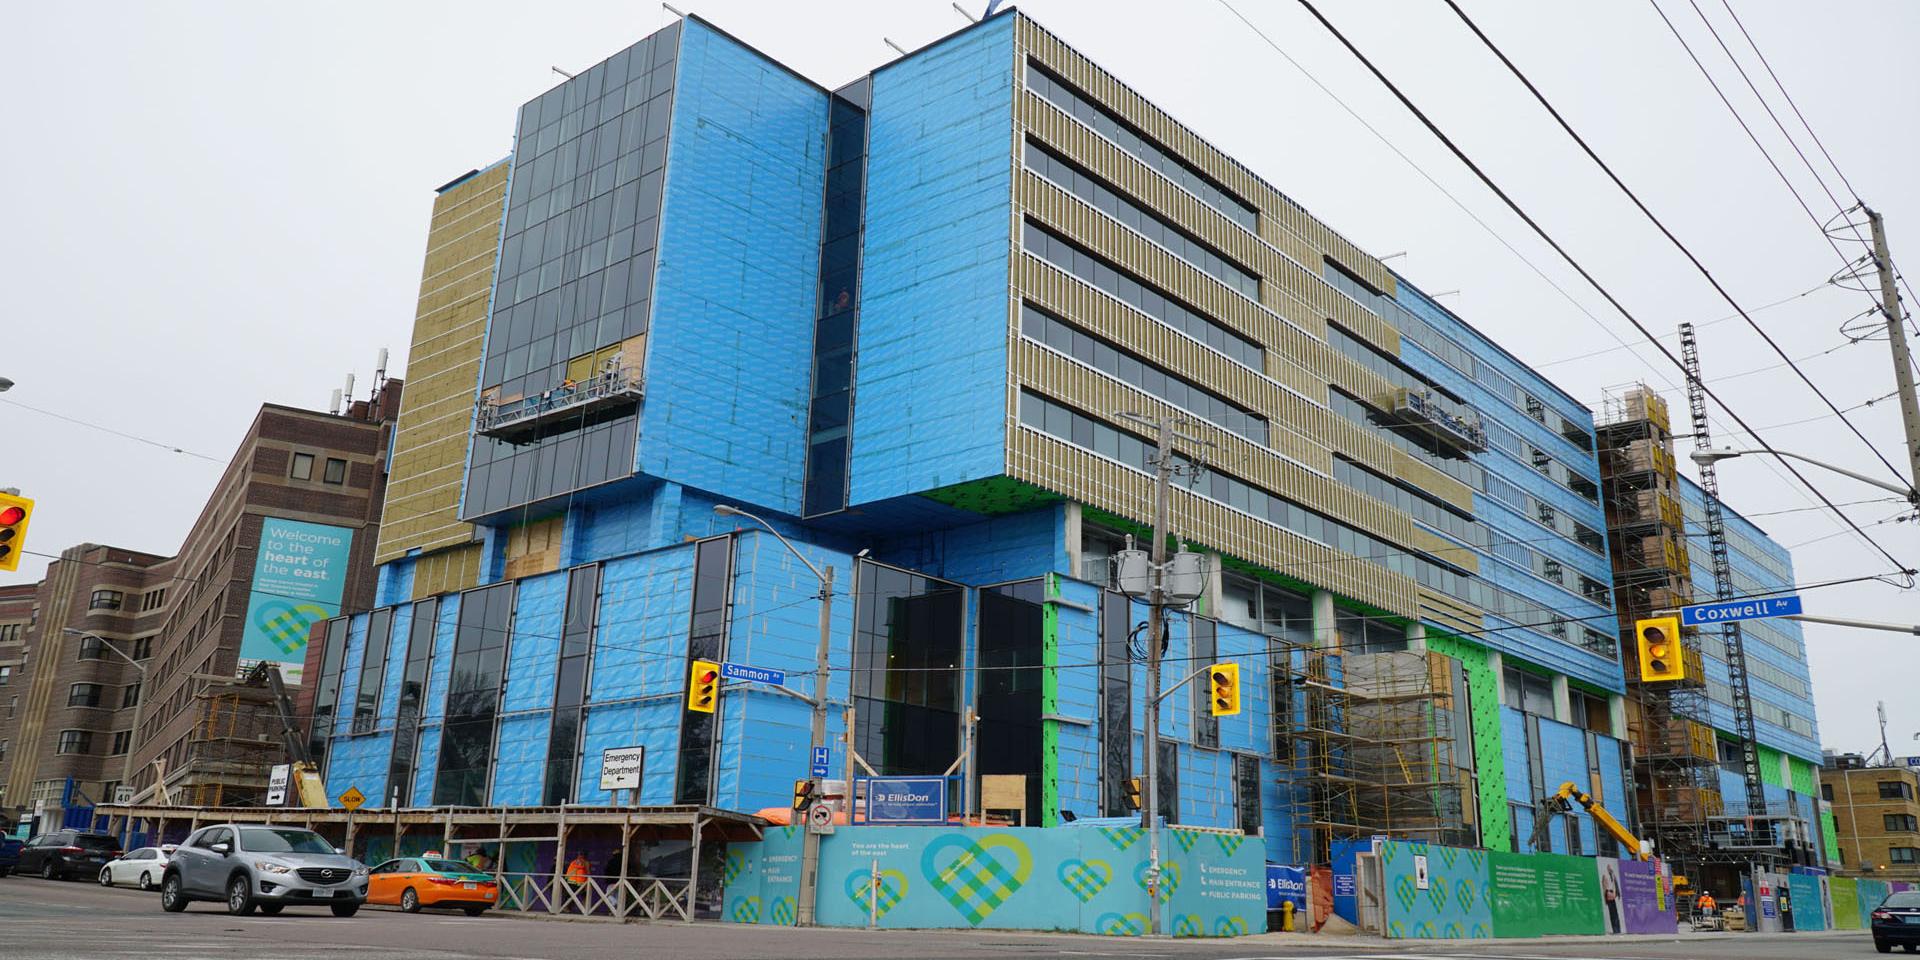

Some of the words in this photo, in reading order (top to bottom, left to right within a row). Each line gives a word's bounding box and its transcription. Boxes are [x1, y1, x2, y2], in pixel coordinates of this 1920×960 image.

[271, 527, 341, 546] Welcome
[267, 540, 283, 551] to
[289, 542, 314, 554] the
[265, 550, 308, 565] heart
[312, 558, 329, 568] of
[263, 563, 289, 575] the
[1694, 601, 1769, 621] Coxwell
[727, 665, 770, 681] Sammon
[605, 753, 640, 763] Emergency
[816, 748, 828, 764] H
[603, 766, 640, 777] Department
[271, 777, 286, 785] PUBLIC
[887, 793, 929, 802] EllisDon
[1208, 866, 1248, 875] EMERGENCY
